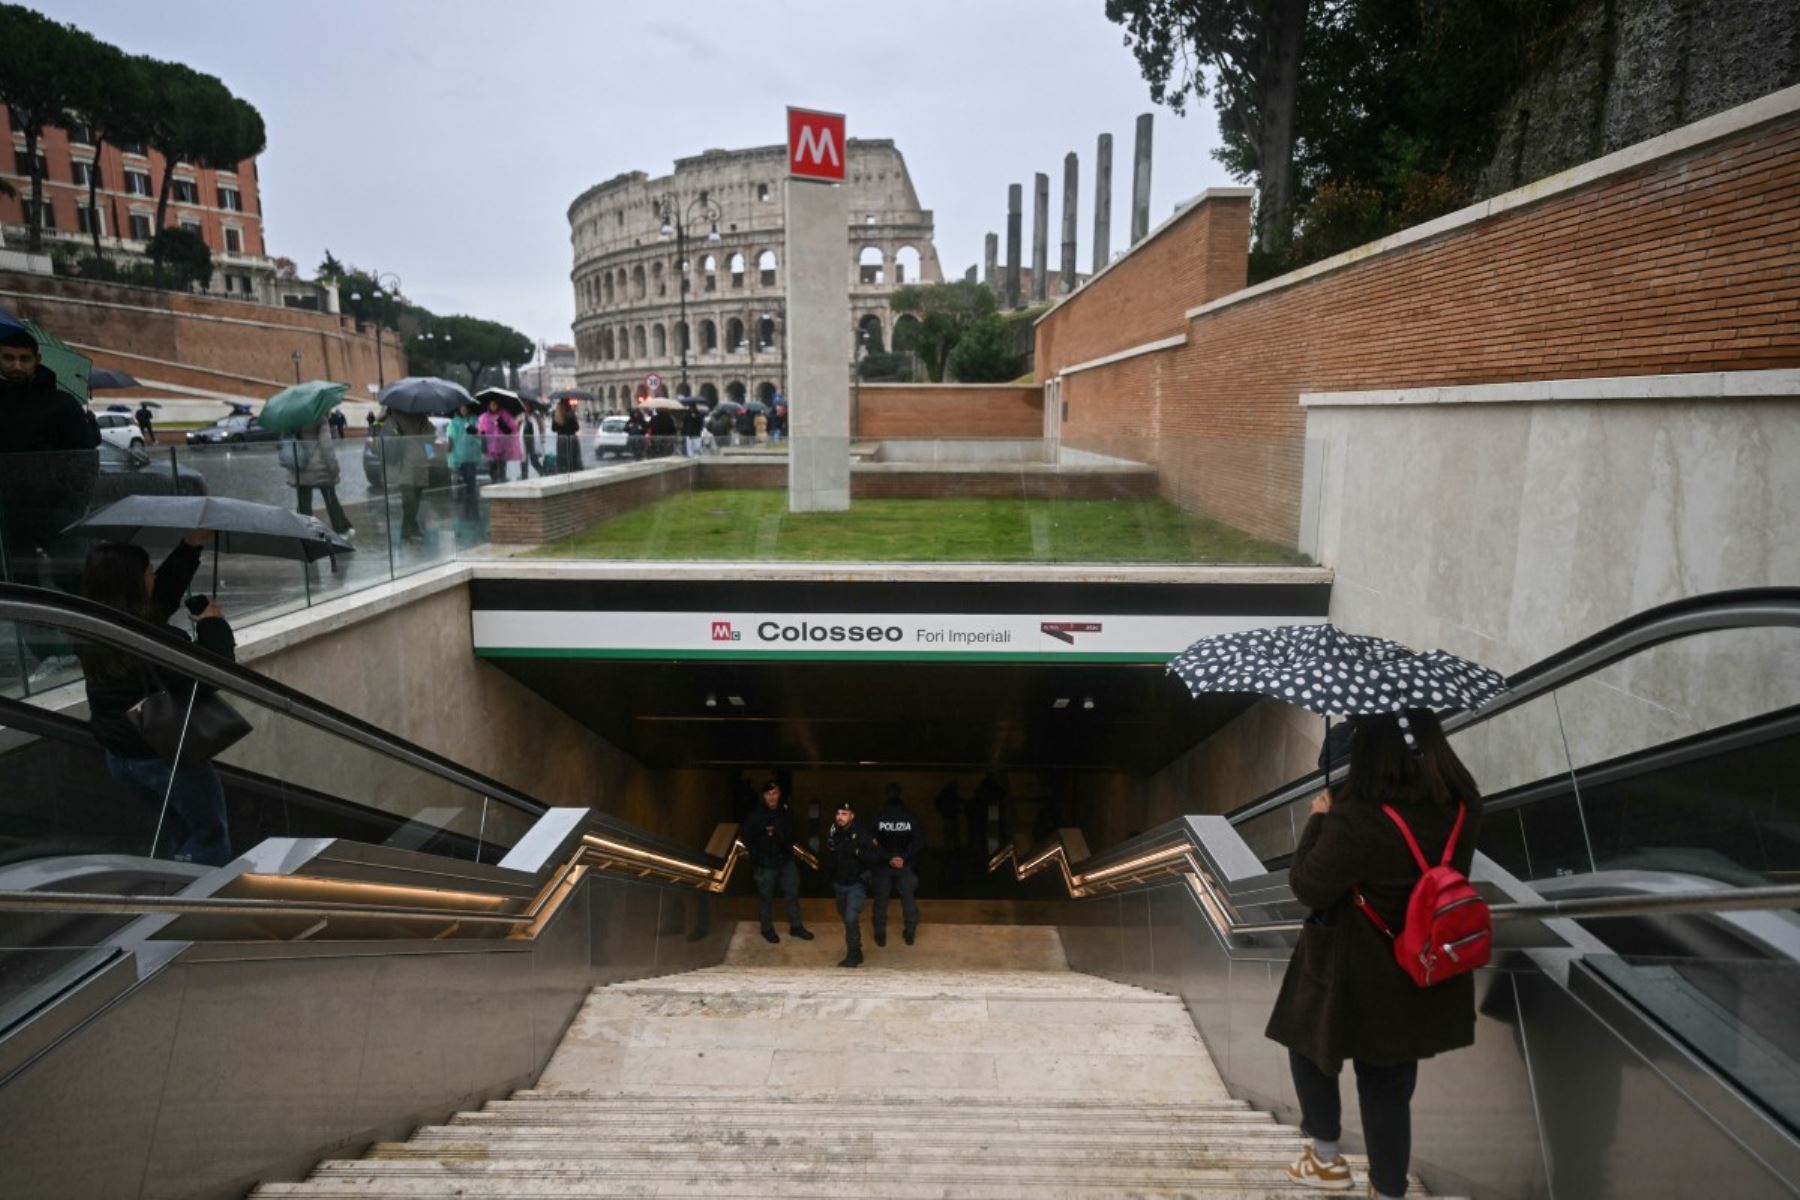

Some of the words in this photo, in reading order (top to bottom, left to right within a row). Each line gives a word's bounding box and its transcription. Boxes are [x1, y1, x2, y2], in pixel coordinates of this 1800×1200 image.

[795, 124, 840, 167] M
[713, 624, 730, 638] M
[757, 621, 904, 642] Colosseo
[916, 629, 945, 643] Fori
[948, 629, 1011, 646] Imperiali
[879, 821, 912, 831] POLIZIA
